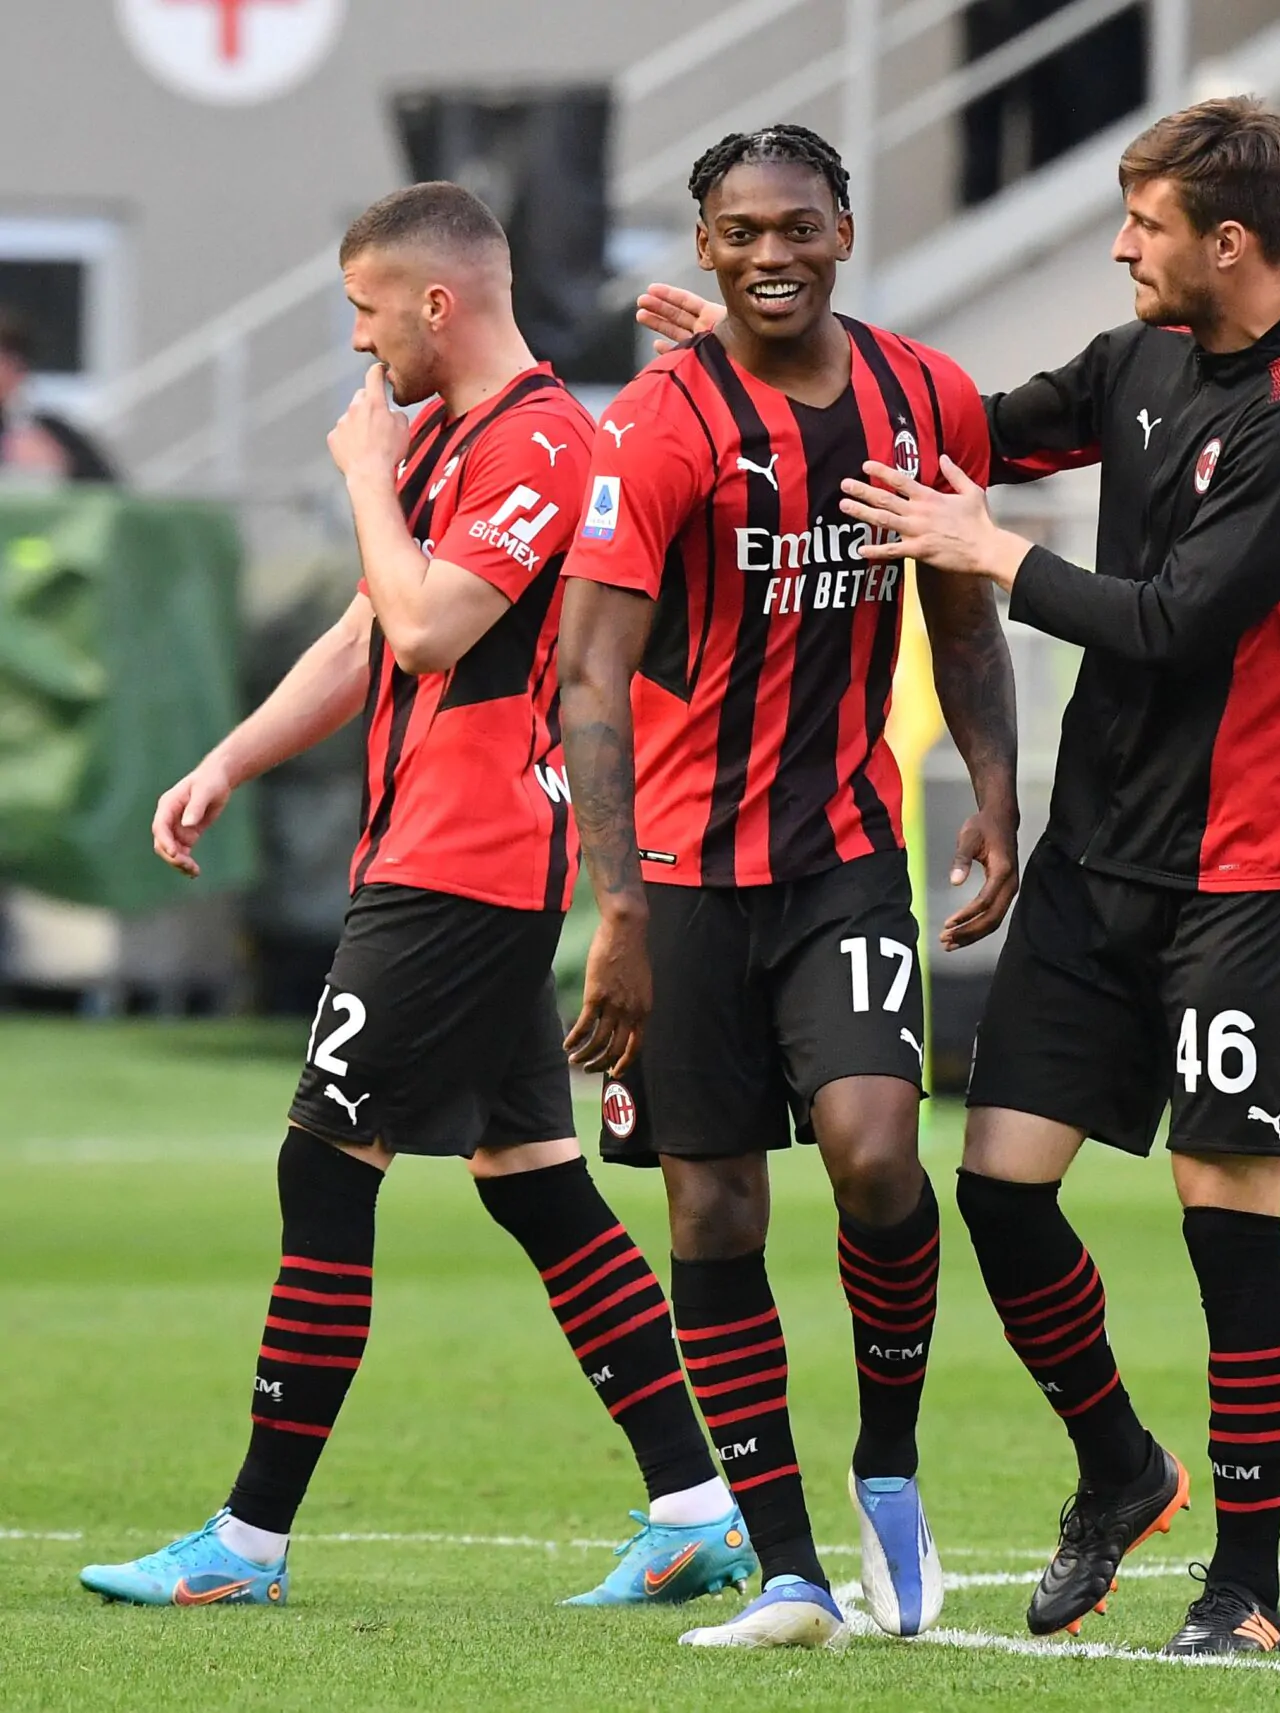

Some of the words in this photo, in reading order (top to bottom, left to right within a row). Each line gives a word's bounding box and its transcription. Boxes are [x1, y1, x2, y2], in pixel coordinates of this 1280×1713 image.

[469, 520, 540, 572] BitMEX
[763, 574, 806, 614] FLY
[840, 937, 912, 1012] 17
[307, 984, 366, 1077] 2
[1176, 1008, 1257, 1094] 46
[869, 1342, 923, 1360] ACM
[1213, 1461, 1261, 1480] ACM
